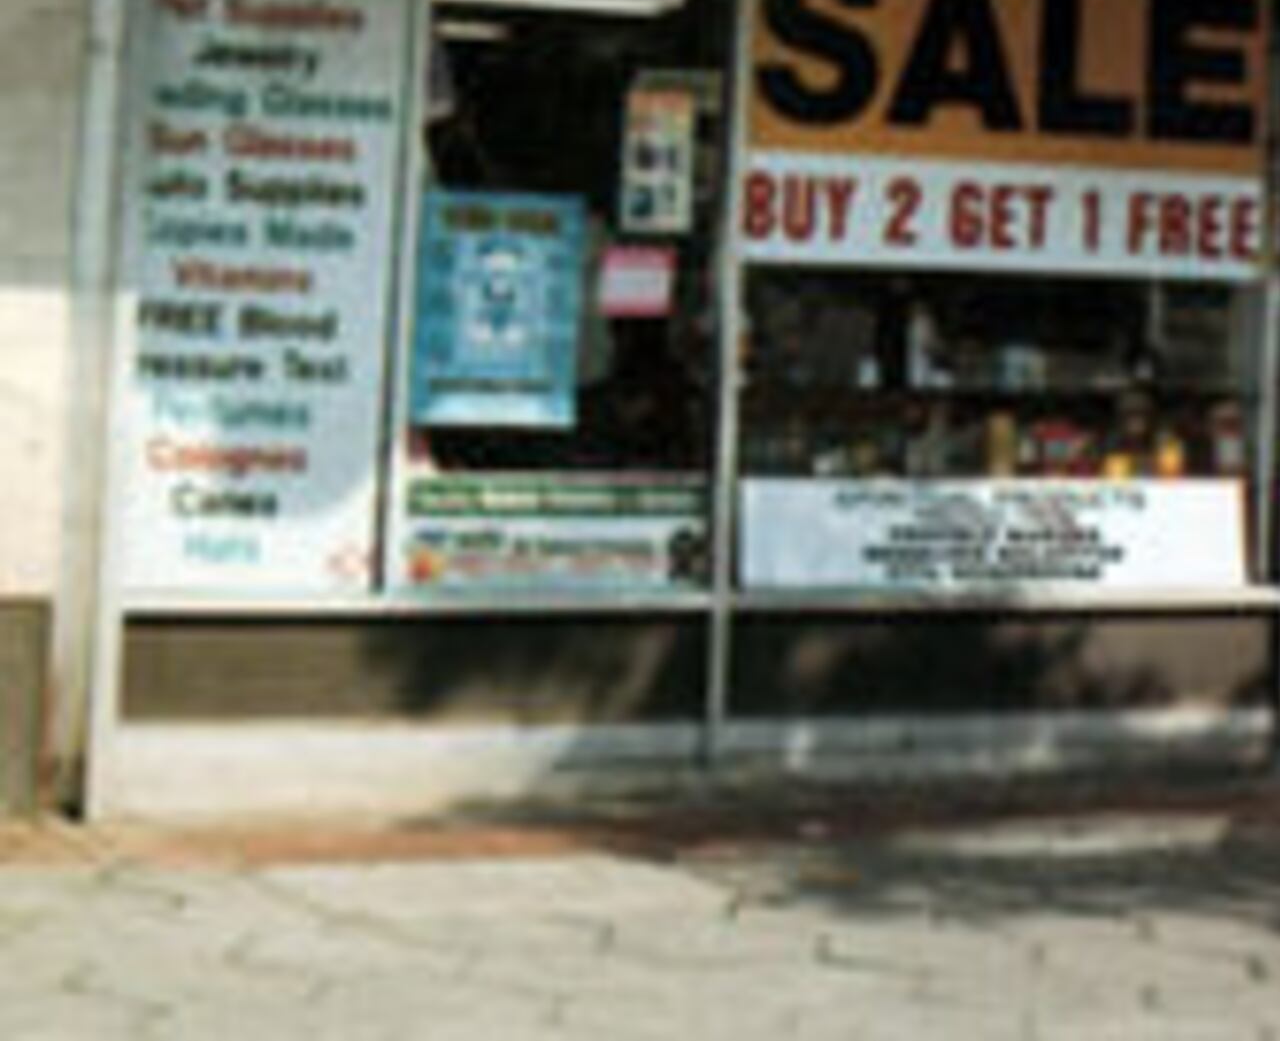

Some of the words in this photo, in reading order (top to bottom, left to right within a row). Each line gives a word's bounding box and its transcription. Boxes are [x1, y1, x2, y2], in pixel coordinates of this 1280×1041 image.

[741, 170, 859, 242] BUY
[884, 177, 923, 246] 2
[949, 180, 1055, 252] GET
[1082, 188, 1102, 253] 1
[1126, 191, 1258, 259] FREE
